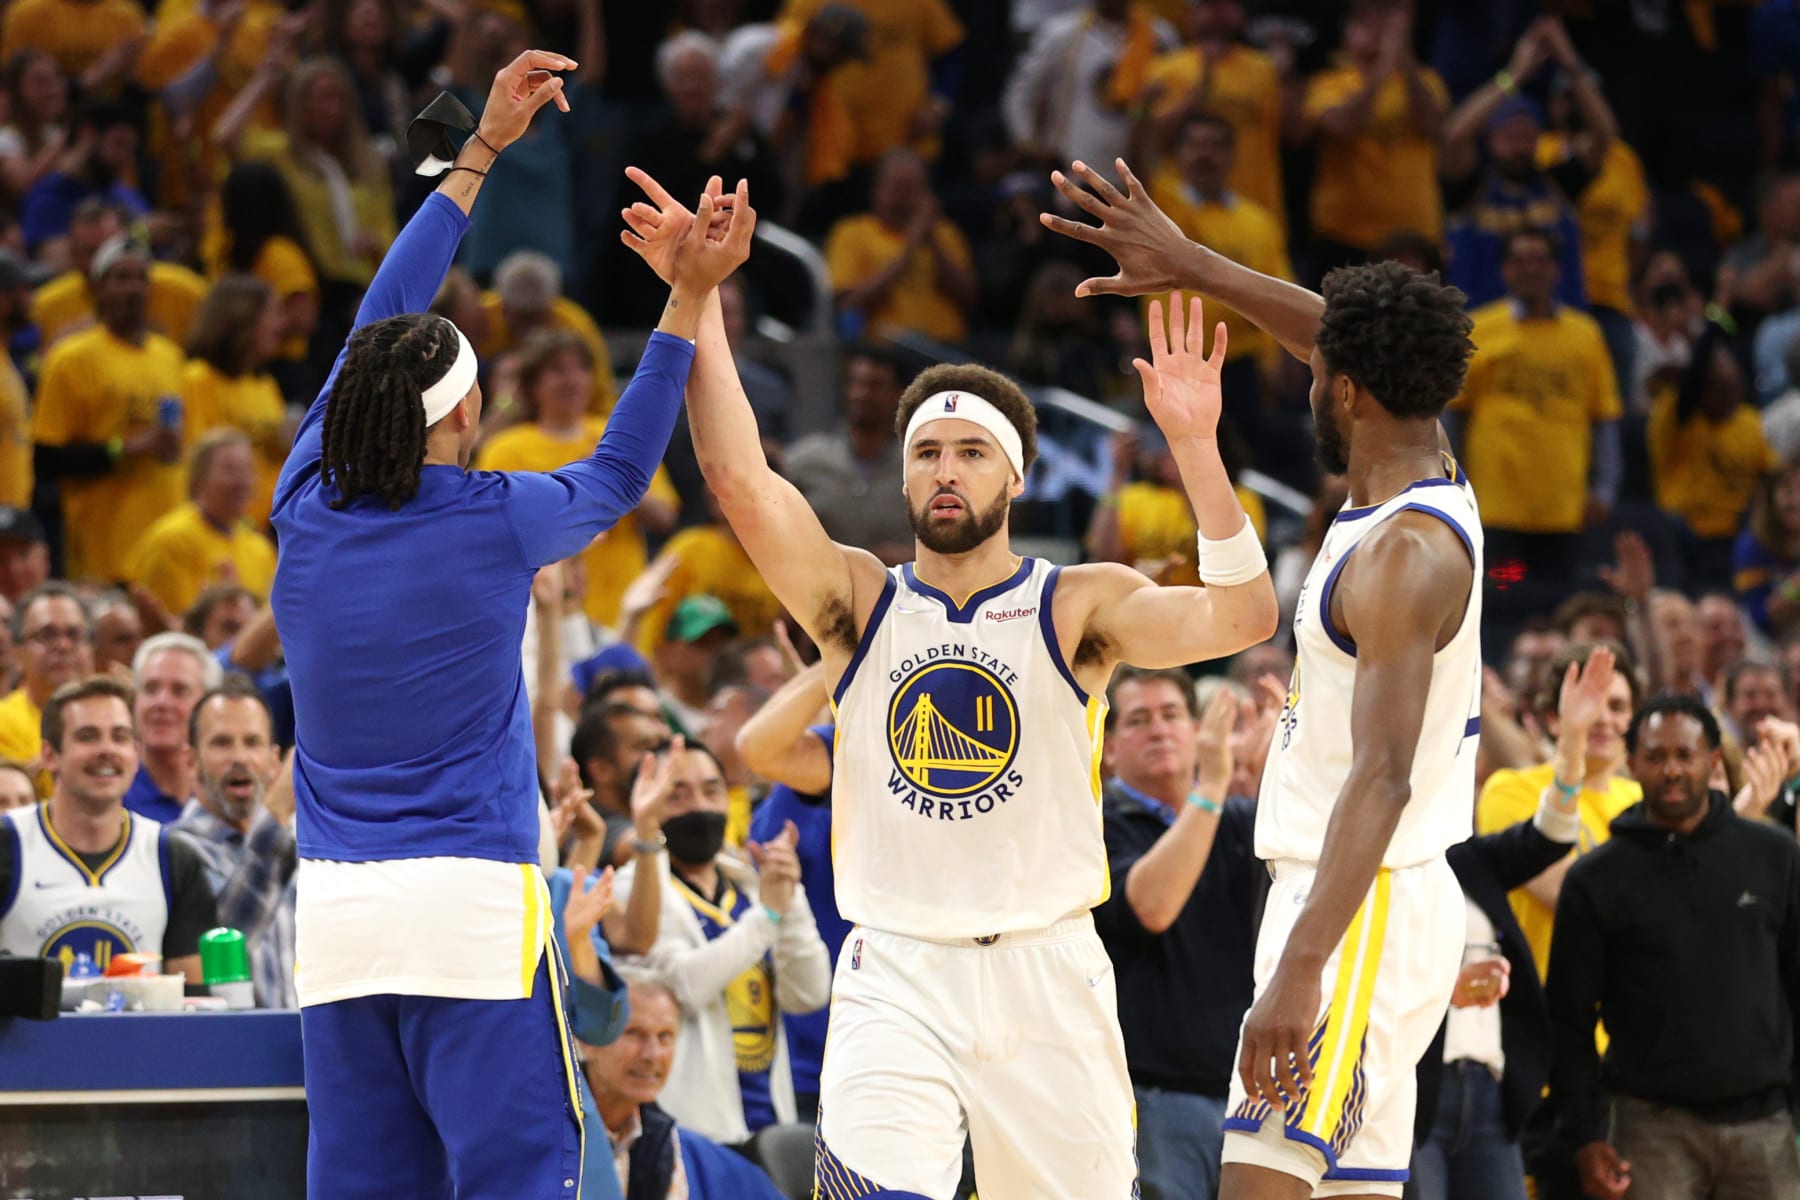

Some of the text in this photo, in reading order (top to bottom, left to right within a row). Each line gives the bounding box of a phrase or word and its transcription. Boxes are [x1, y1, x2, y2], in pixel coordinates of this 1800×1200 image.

[985, 606, 1037, 623] Rakuten
[890, 643, 1019, 687] GOLDEN STATE
[976, 695, 994, 732] 11
[887, 768, 1024, 821] WARRIORS
